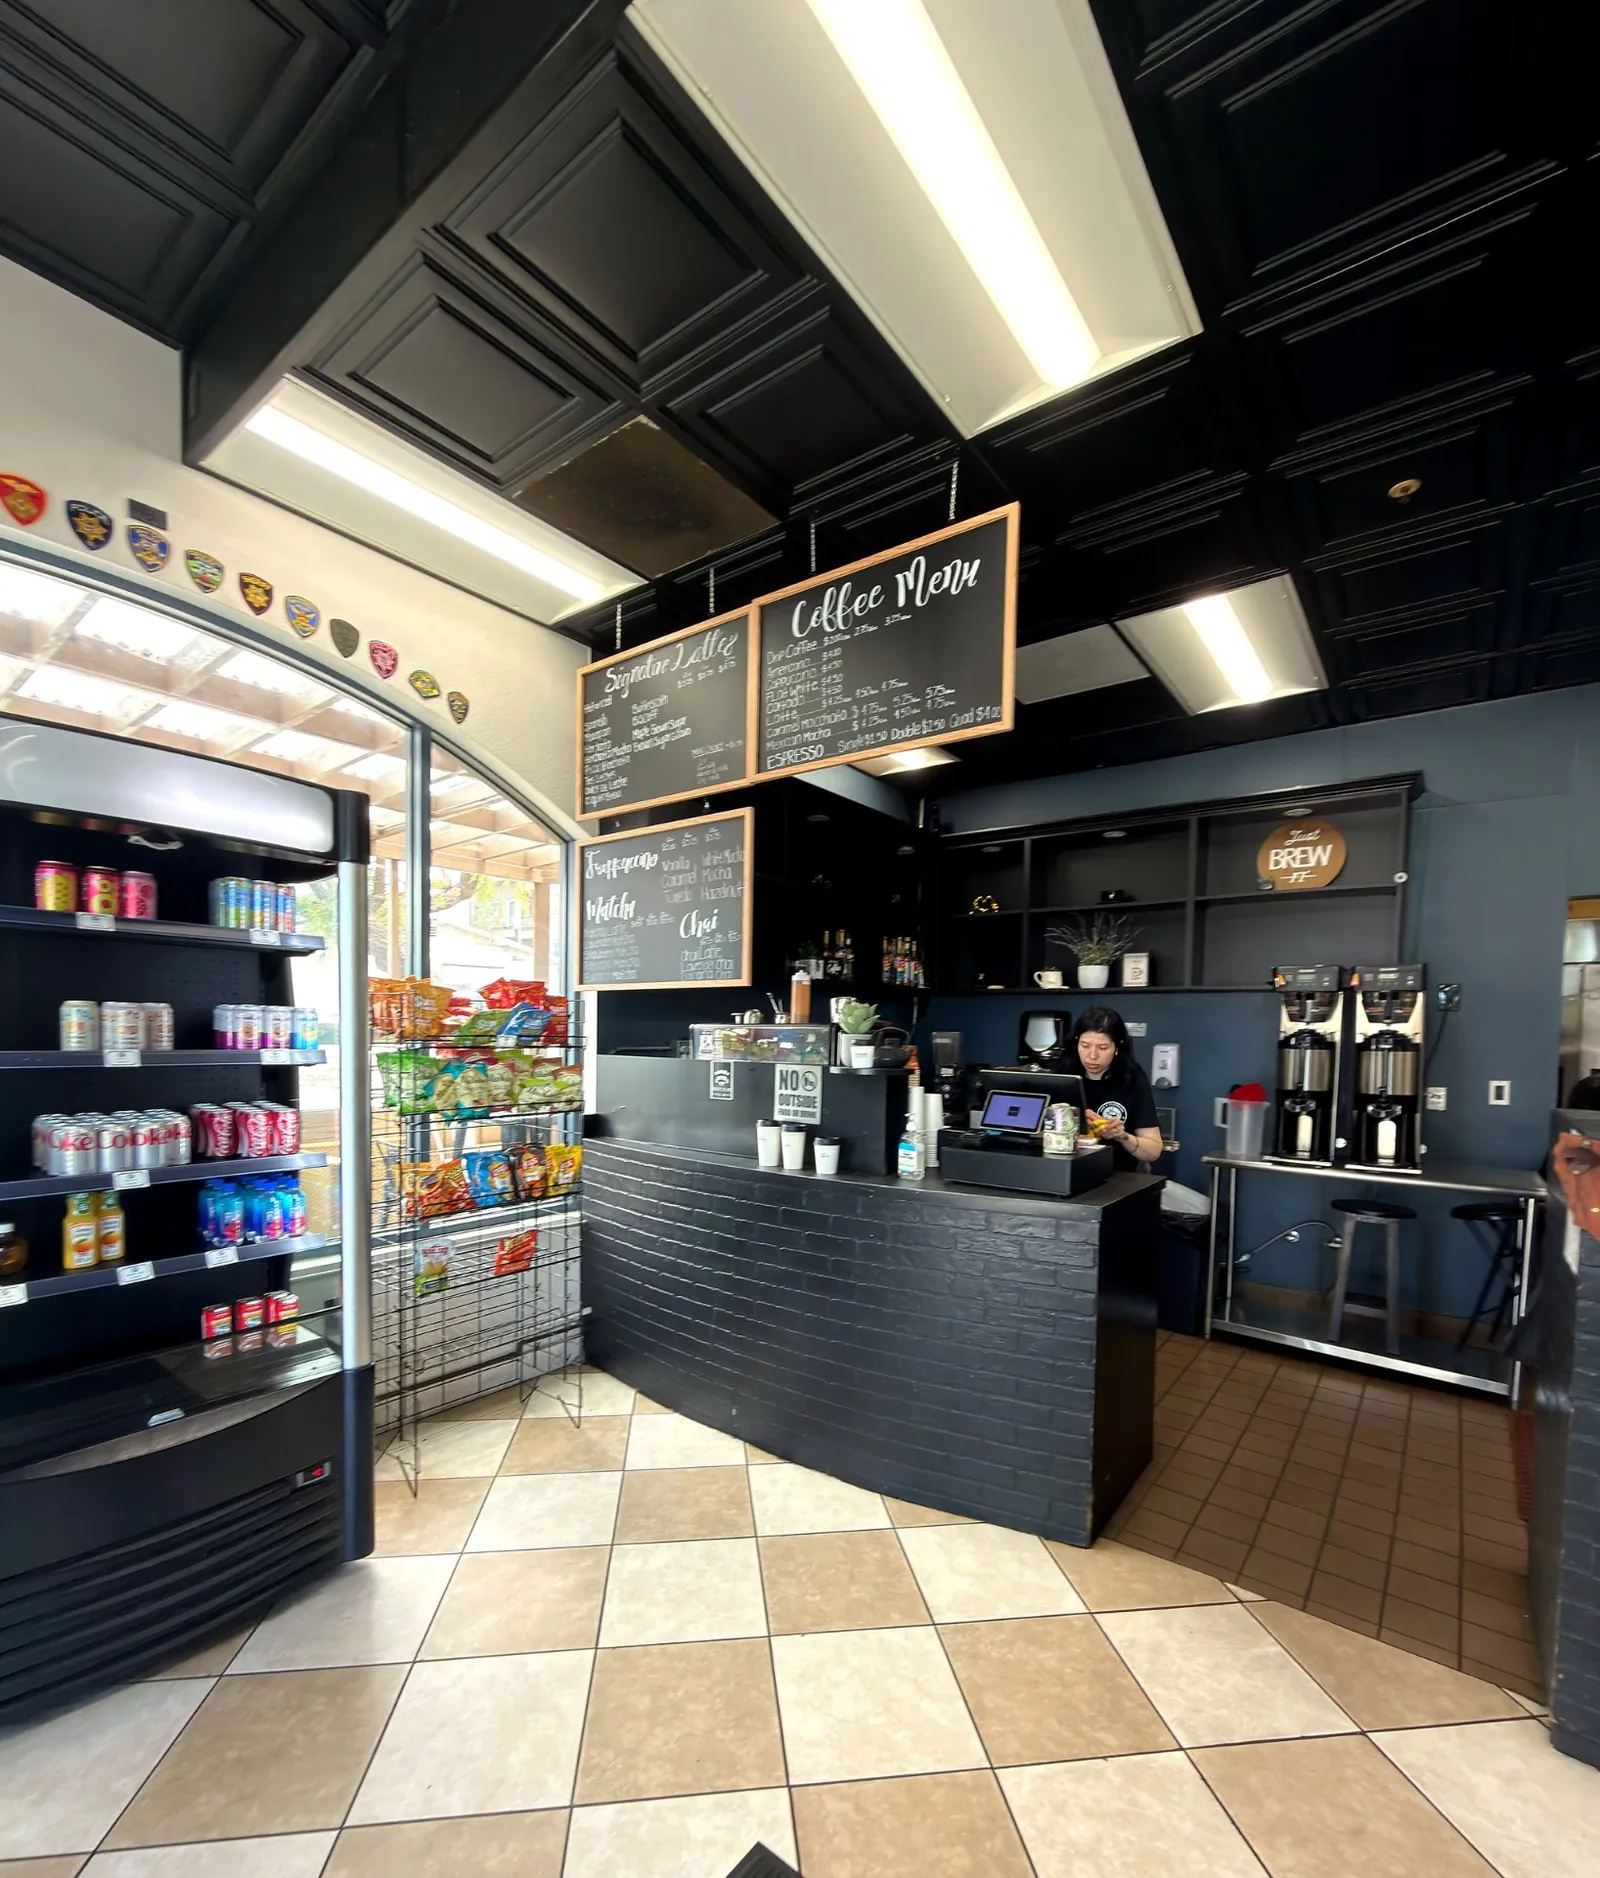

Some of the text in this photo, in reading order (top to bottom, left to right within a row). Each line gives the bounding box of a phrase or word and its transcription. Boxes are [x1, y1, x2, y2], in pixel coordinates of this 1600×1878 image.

[792, 555, 981, 638] Coffee Menu
[767, 744, 824, 770] ESPRESSO
[1268, 844, 1334, 870] BREW
[679, 908, 719, 939] Chai
[779, 1070, 799, 1091] NO
[778, 1093, 818, 1109] OUTSIDE
